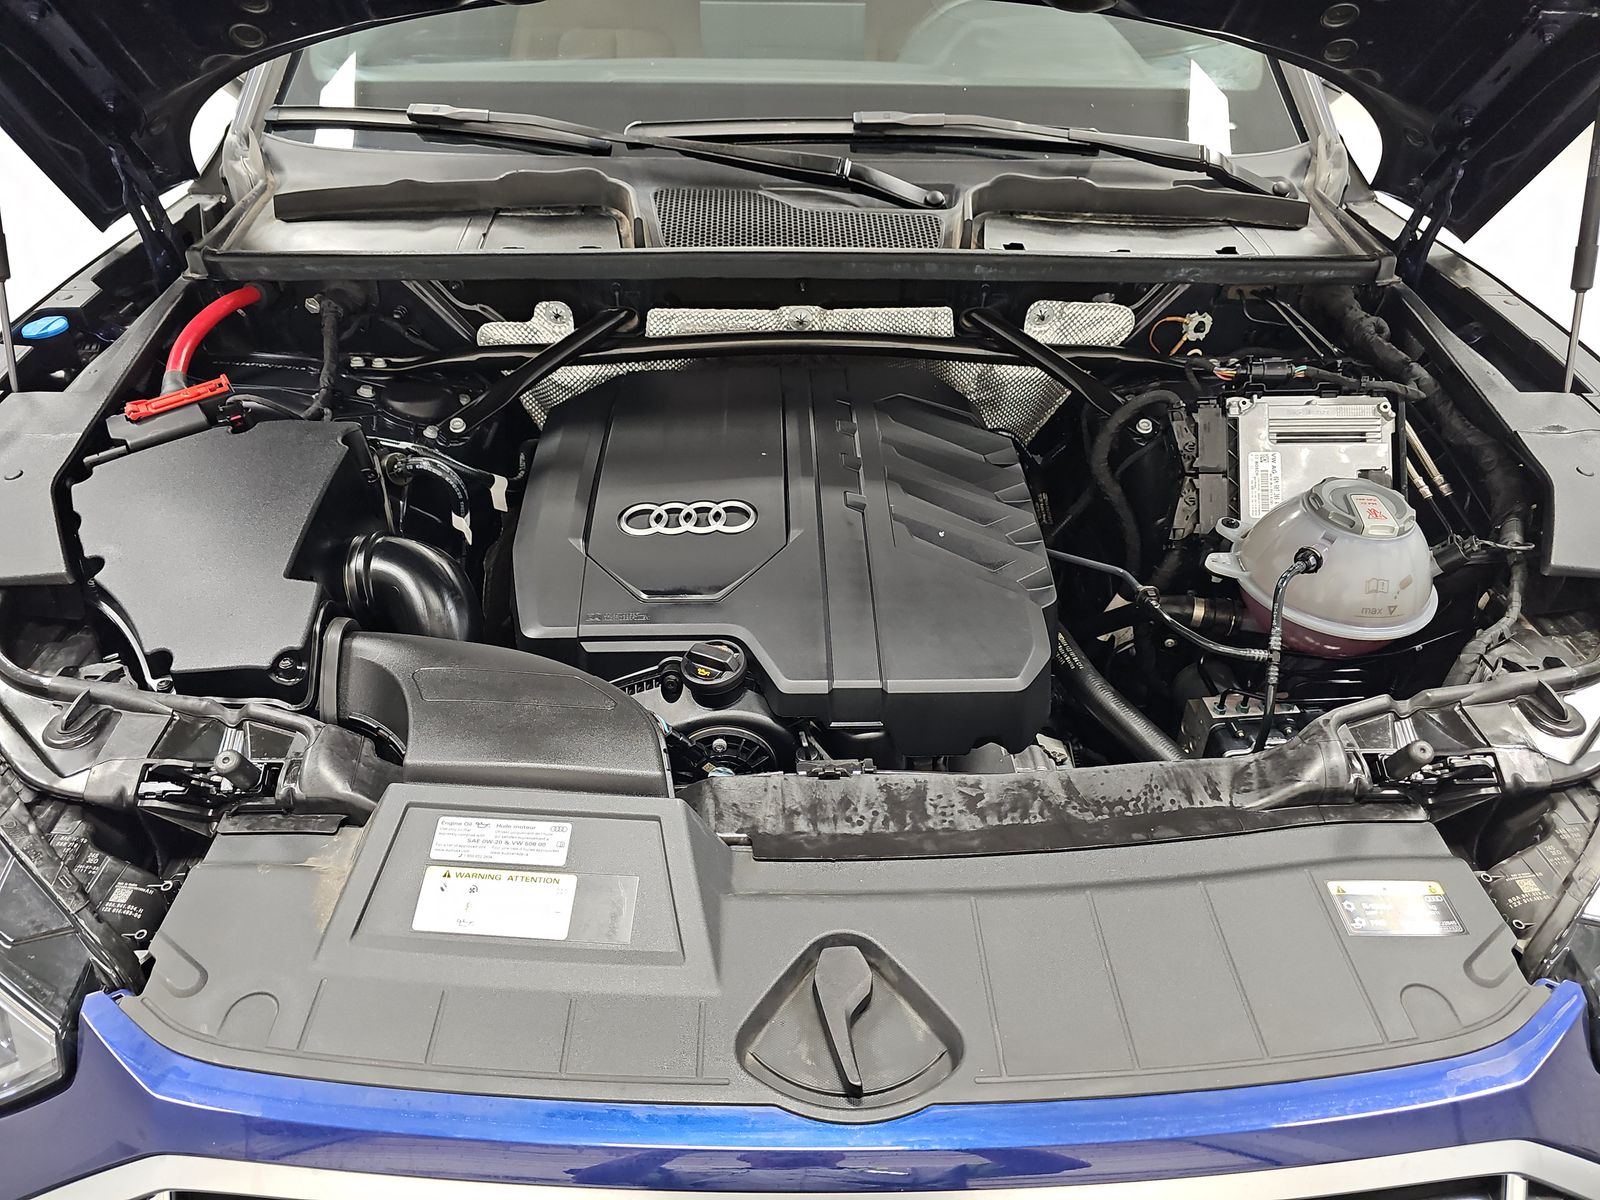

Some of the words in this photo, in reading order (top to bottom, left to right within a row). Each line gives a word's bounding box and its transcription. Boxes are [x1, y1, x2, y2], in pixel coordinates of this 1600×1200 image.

[1360, 605, 1383, 616] max
[455, 871, 502, 881] WARNING
[507, 874, 561, 885] ATTENTION
